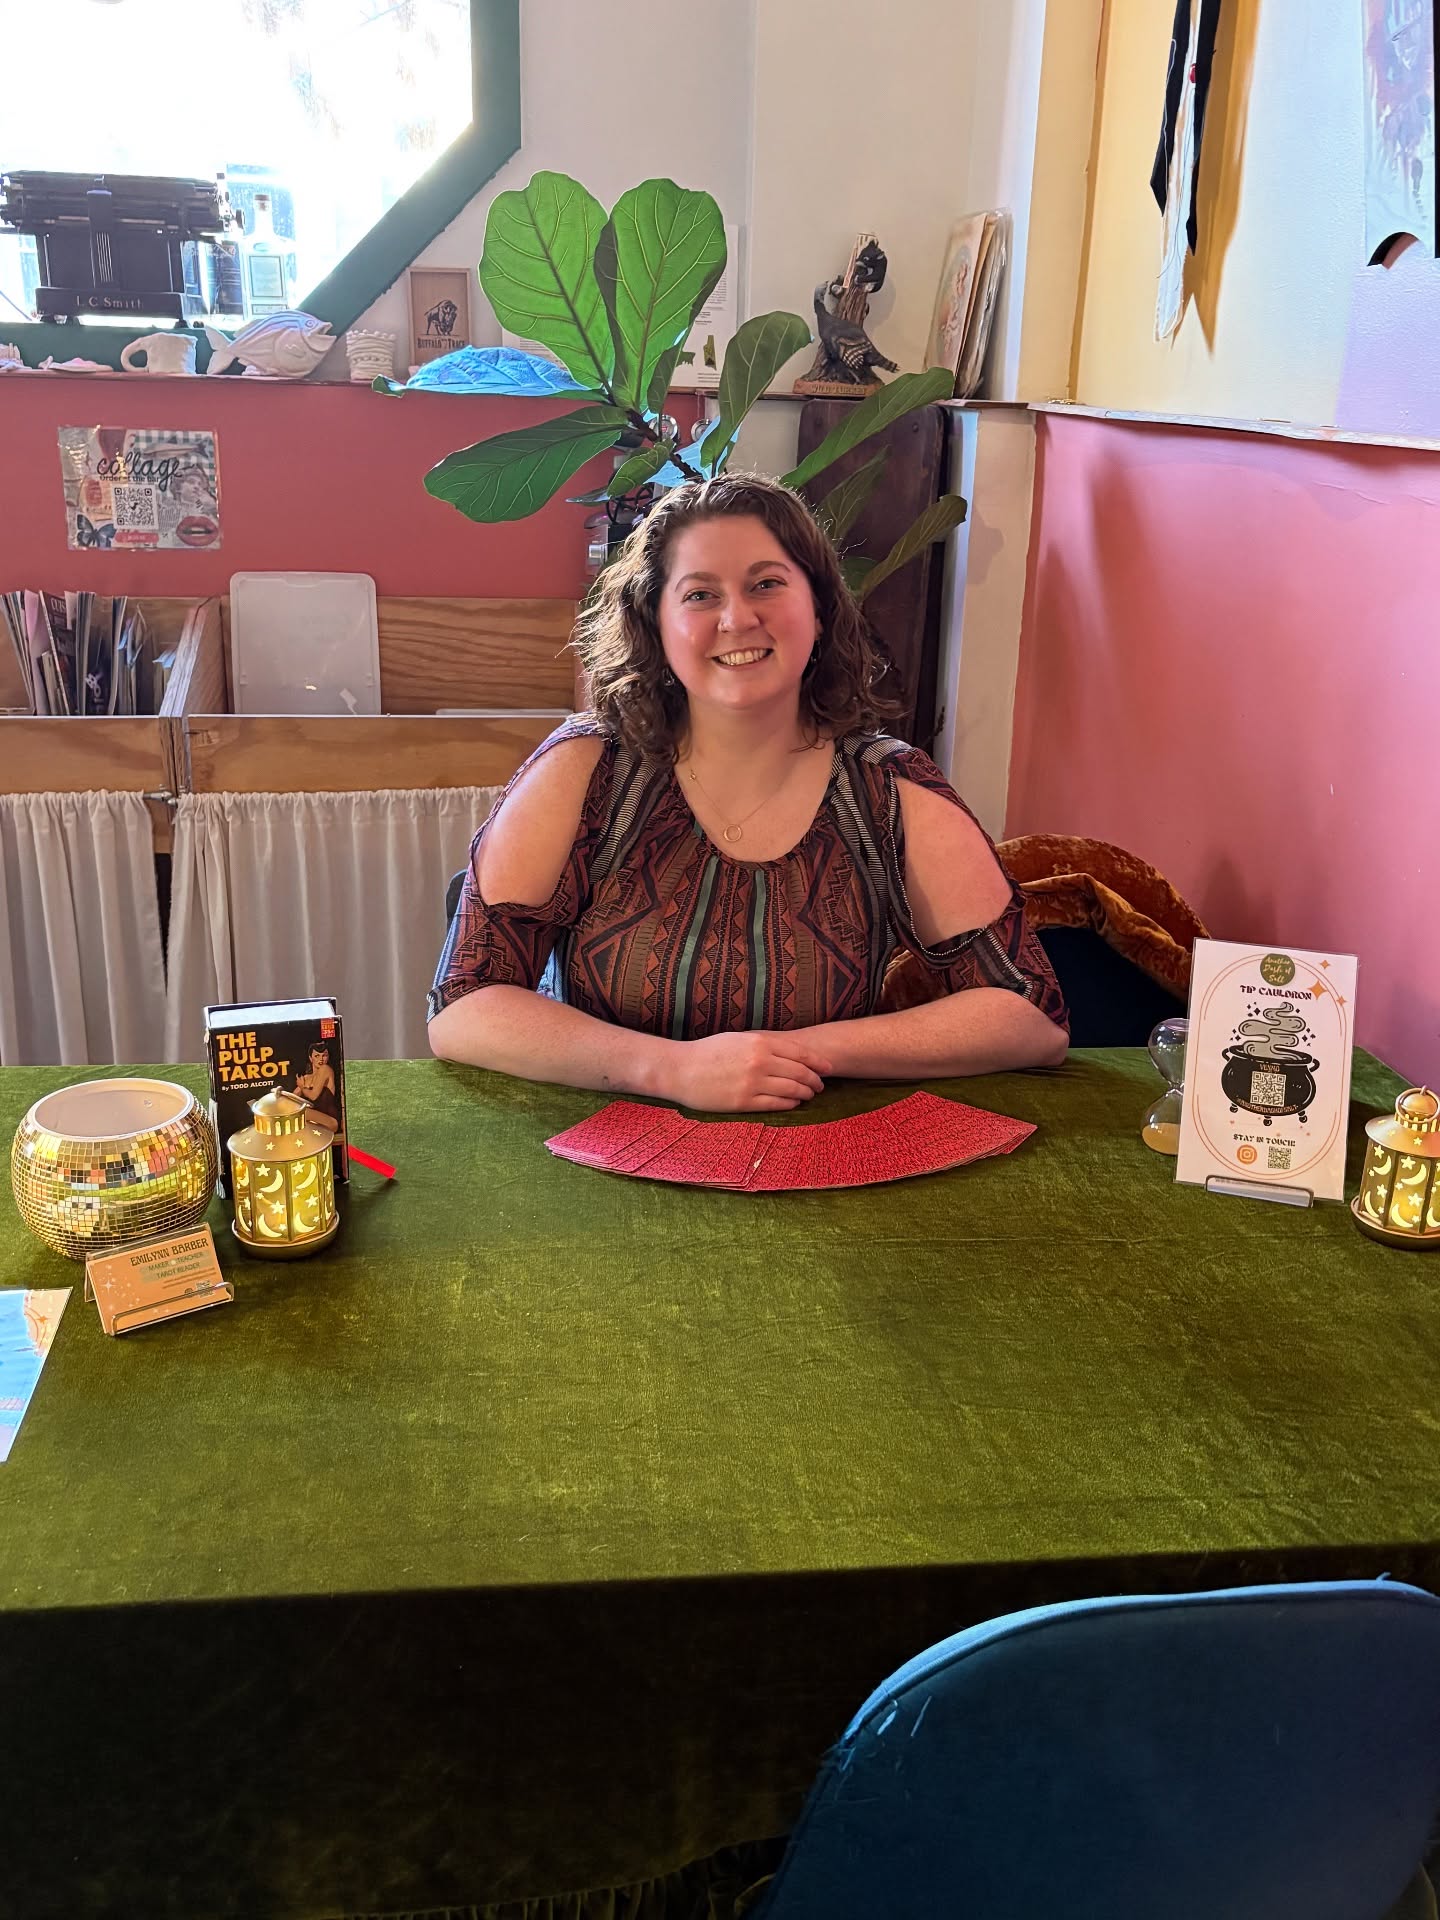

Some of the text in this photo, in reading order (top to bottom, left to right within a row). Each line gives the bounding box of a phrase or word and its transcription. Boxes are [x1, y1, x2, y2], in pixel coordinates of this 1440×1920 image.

[88, 296, 98, 308] C
[103, 297, 144, 310] Smith
[96, 451, 183, 492] collage
[1239, 984, 1312, 1000] TIP CAULDRON
[216, 1031, 257, 1050] THE
[219, 1046, 274, 1067] PULP
[218, 1060, 291, 1083] TAROT
[230, 1082, 249, 1090] TODD
[250, 1080, 275, 1088] ALCOTT
[1233, 1133, 1254, 1143] STAY
[1256, 1135, 1264, 1143] IN
[130, 1237, 209, 1267] EMILYNN BARBER
[148, 1260, 169, 1271] MAKER
[156, 1268, 177, 1279] TAROT
